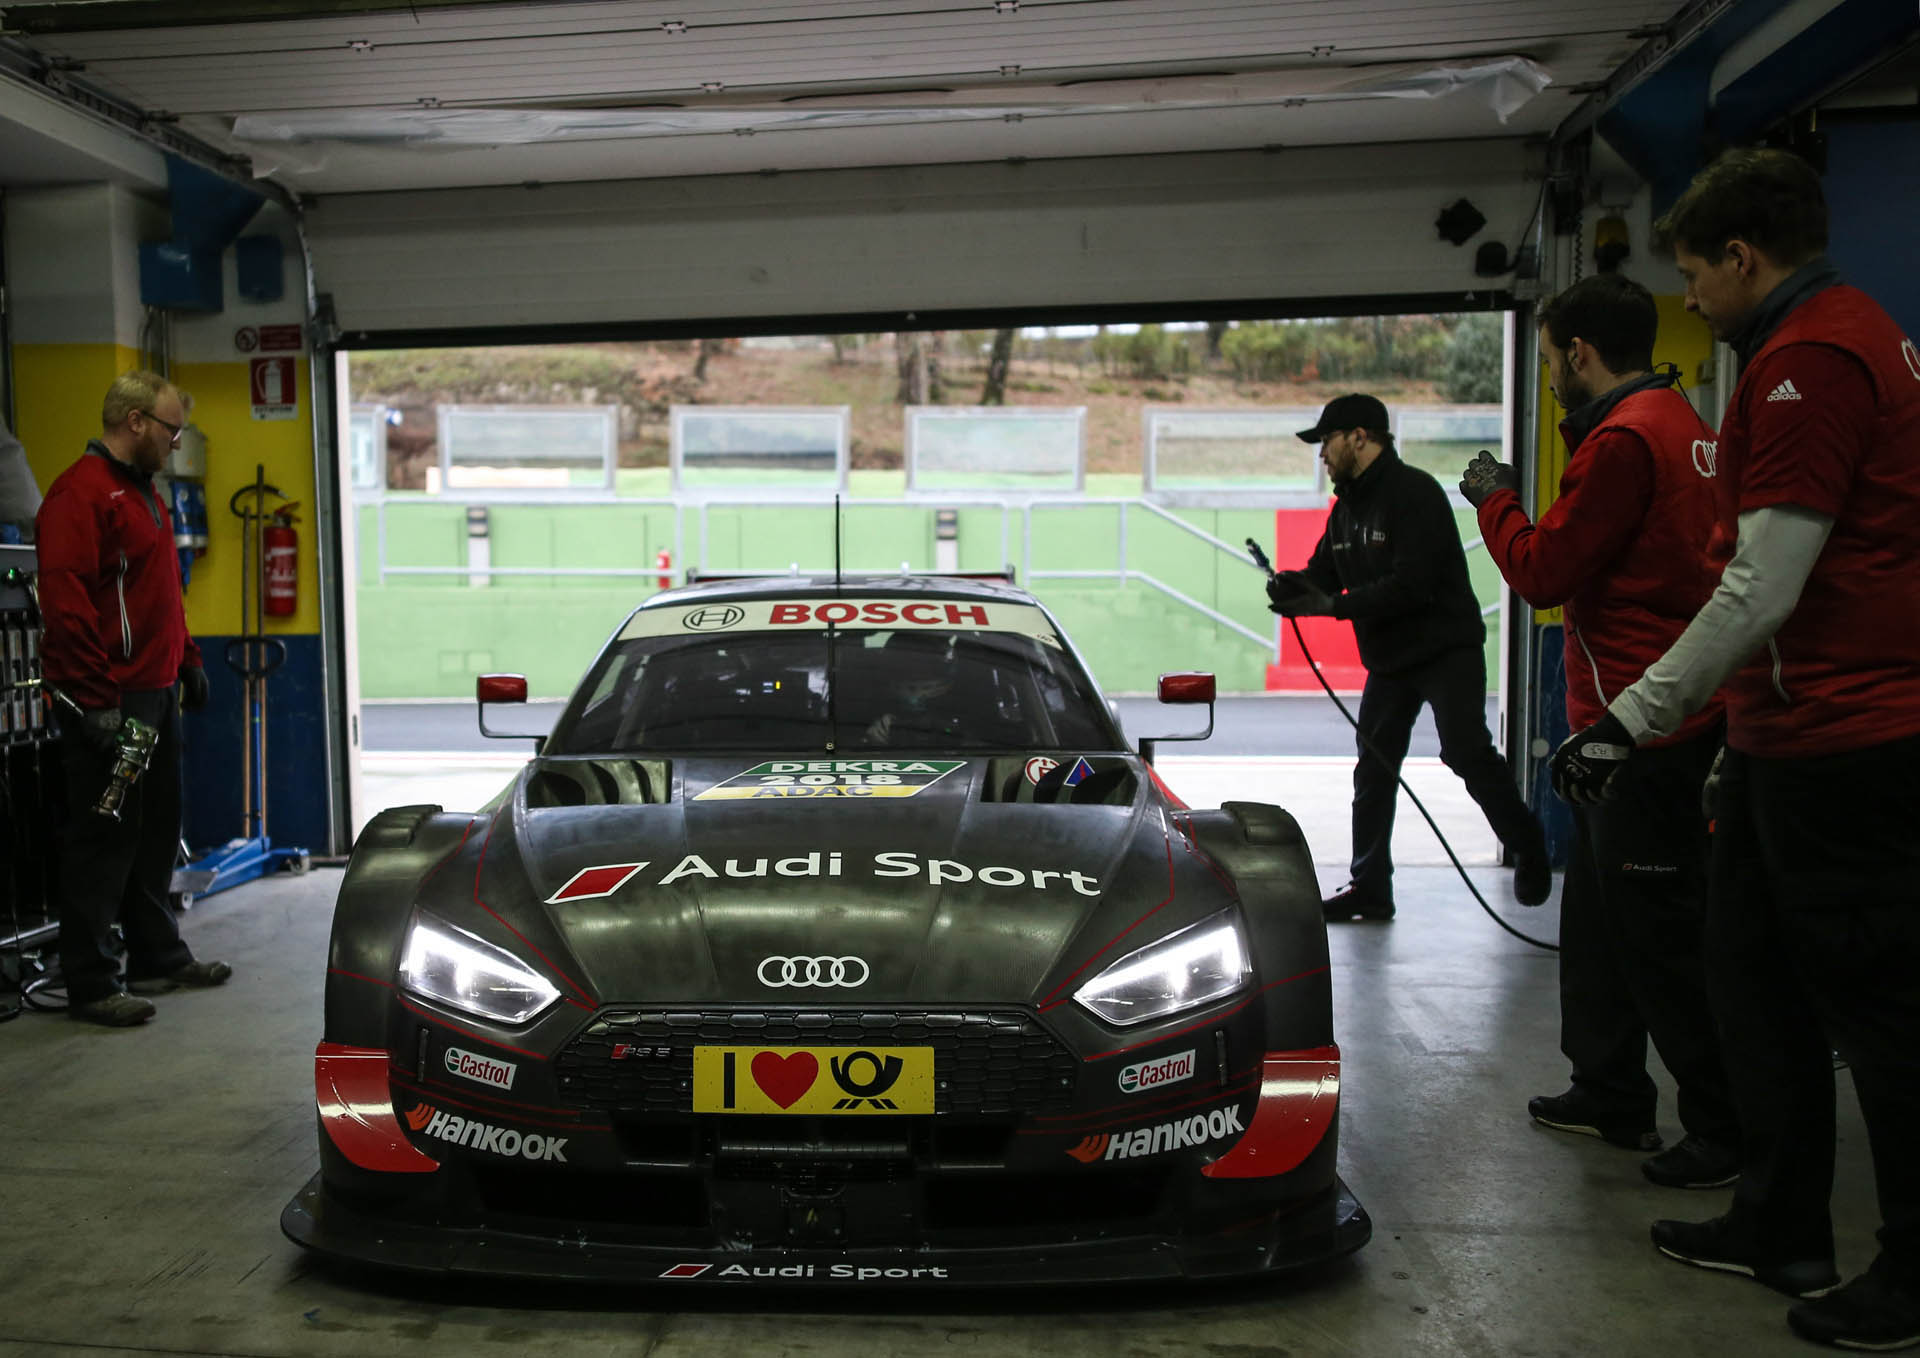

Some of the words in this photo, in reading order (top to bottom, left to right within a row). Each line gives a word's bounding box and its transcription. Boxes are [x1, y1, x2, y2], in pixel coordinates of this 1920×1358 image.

[1767, 392, 1802, 401] adidas
[769, 603, 989, 625] BOSCH
[771, 762, 939, 773] DEKRA
[759, 775, 902, 786] 2018
[752, 786, 873, 797] ADAC
[657, 852, 842, 885] Audi
[873, 852, 1101, 897] Sport
[460, 1054, 510, 1085] Castrol
[1139, 1055, 1191, 1086] Castrol
[724, 1052, 735, 1108] I
[718, 1264, 815, 1277] Audi
[829, 1264, 949, 1280] Sport
